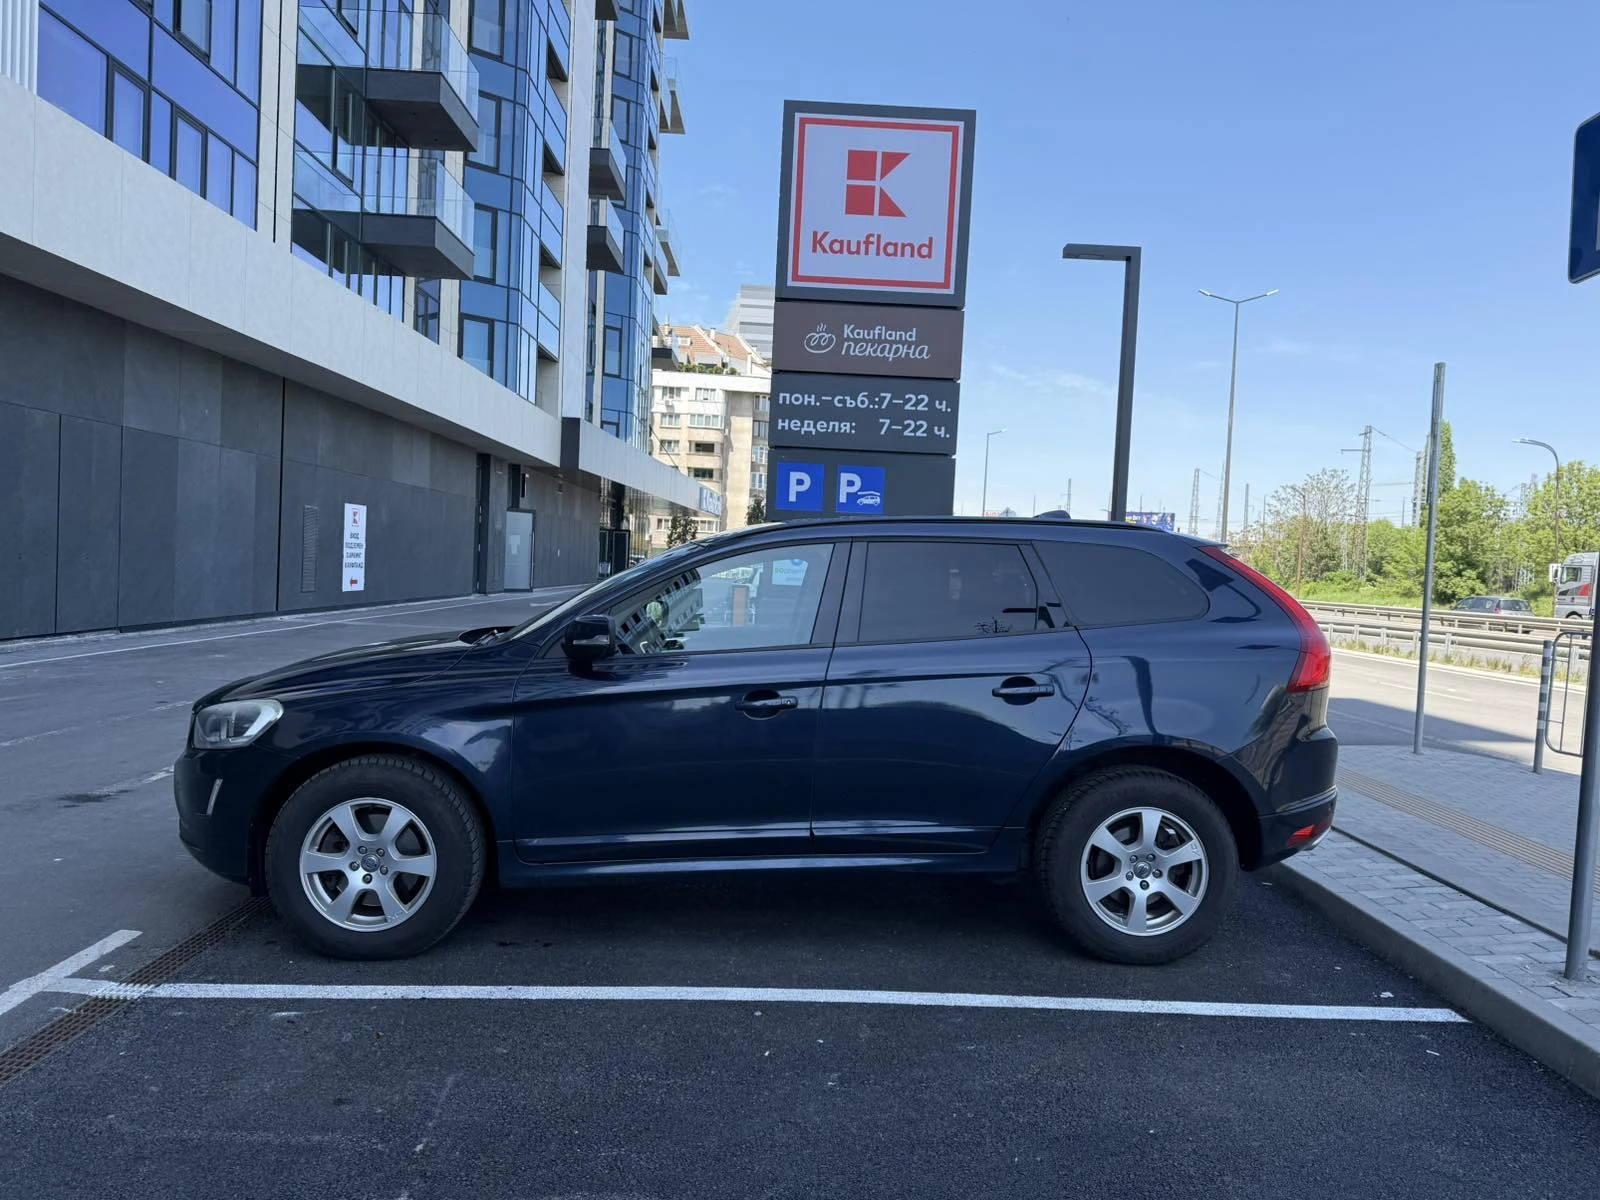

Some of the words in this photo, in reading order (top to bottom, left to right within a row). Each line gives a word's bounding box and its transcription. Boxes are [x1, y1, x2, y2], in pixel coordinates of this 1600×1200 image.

[811, 230, 933, 259] Kaufland
[843, 324, 917, 341] Kaufland
[841, 341, 931, 362] пекарна
[935, 399, 952, 412] ч.
[777, 418, 856, 435] неделя:
[879, 418, 928, 437] 7–22
[934, 425, 950, 438] ч.
[788, 471, 811, 502] P
[839, 472, 862, 503] P
